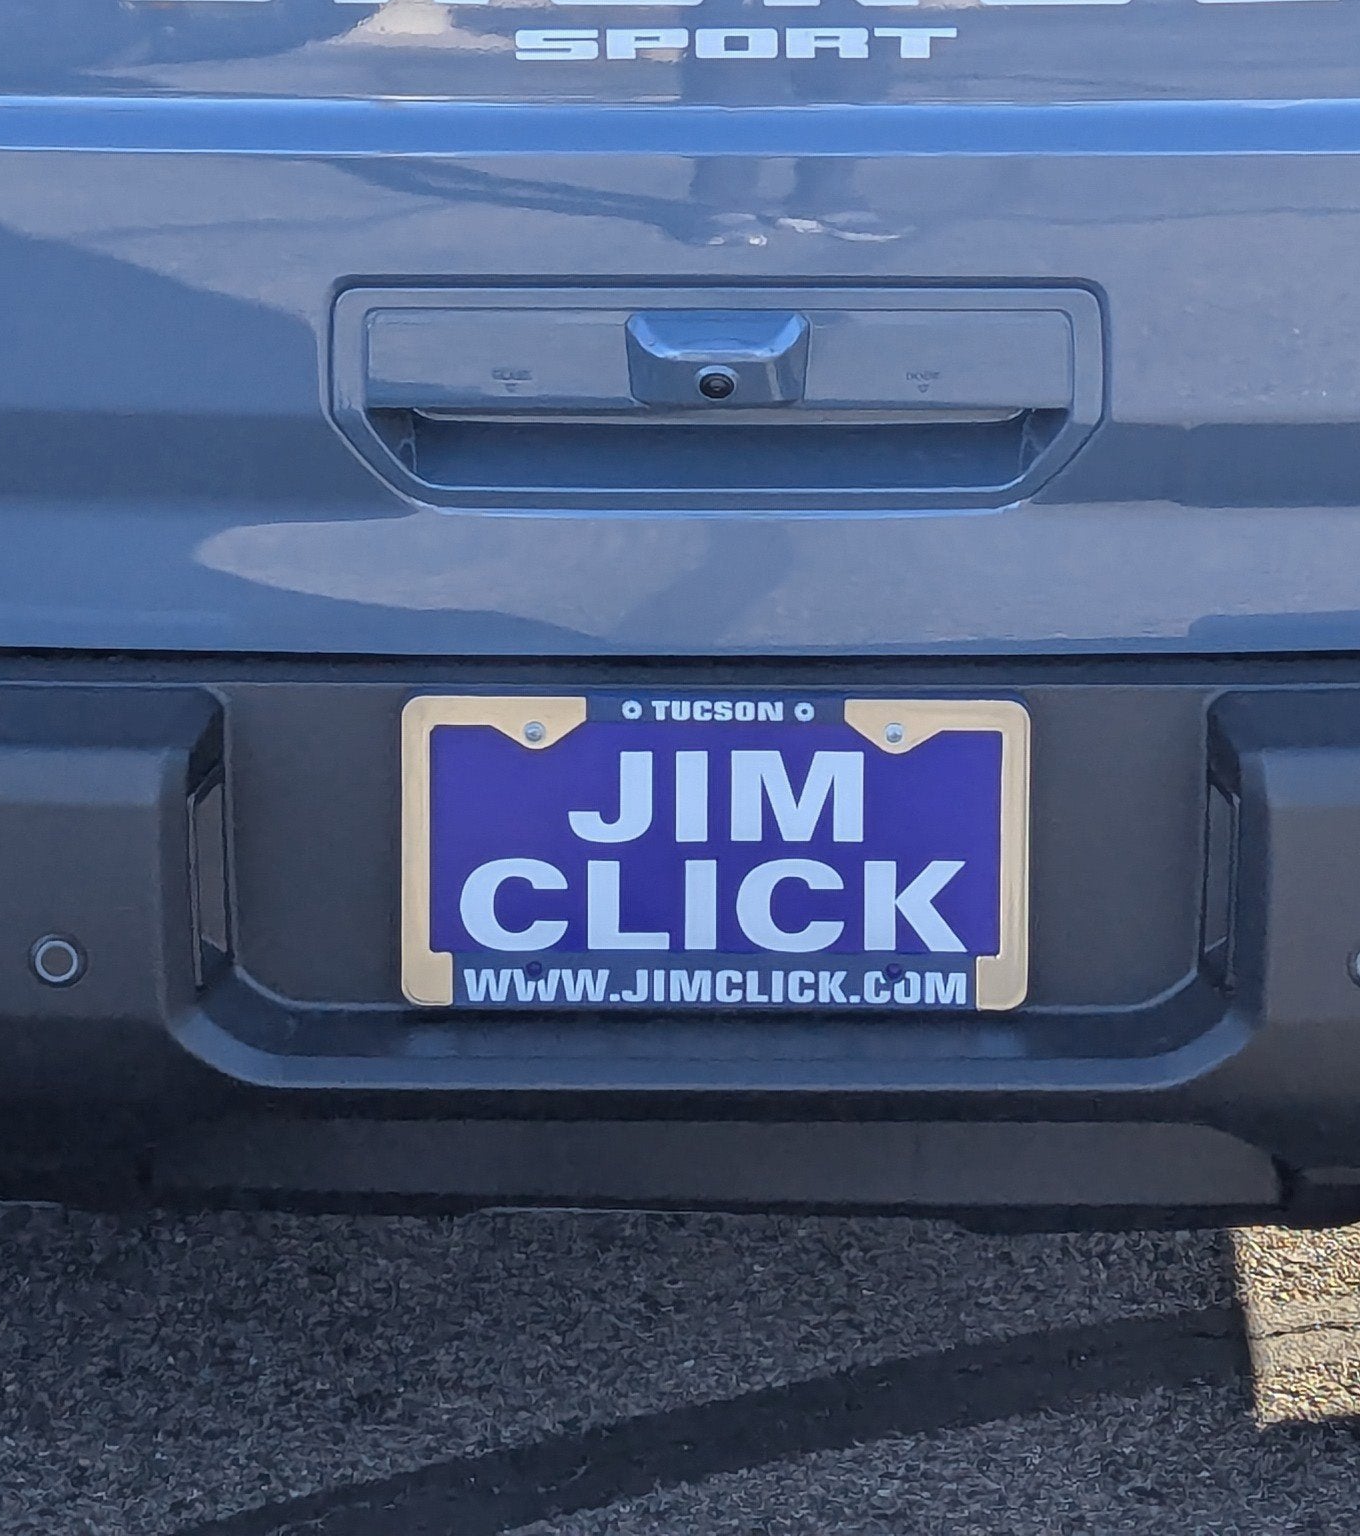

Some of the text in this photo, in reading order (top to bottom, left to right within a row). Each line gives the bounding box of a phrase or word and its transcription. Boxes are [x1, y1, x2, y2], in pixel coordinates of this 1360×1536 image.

[514, 26, 958, 63] SPORT
[650, 699, 784, 722] TUCSON
[567, 749, 865, 844] JIM
[458, 856, 968, 954] CLICK
[463, 967, 967, 1005] WWW.JIMCLICK.COM
